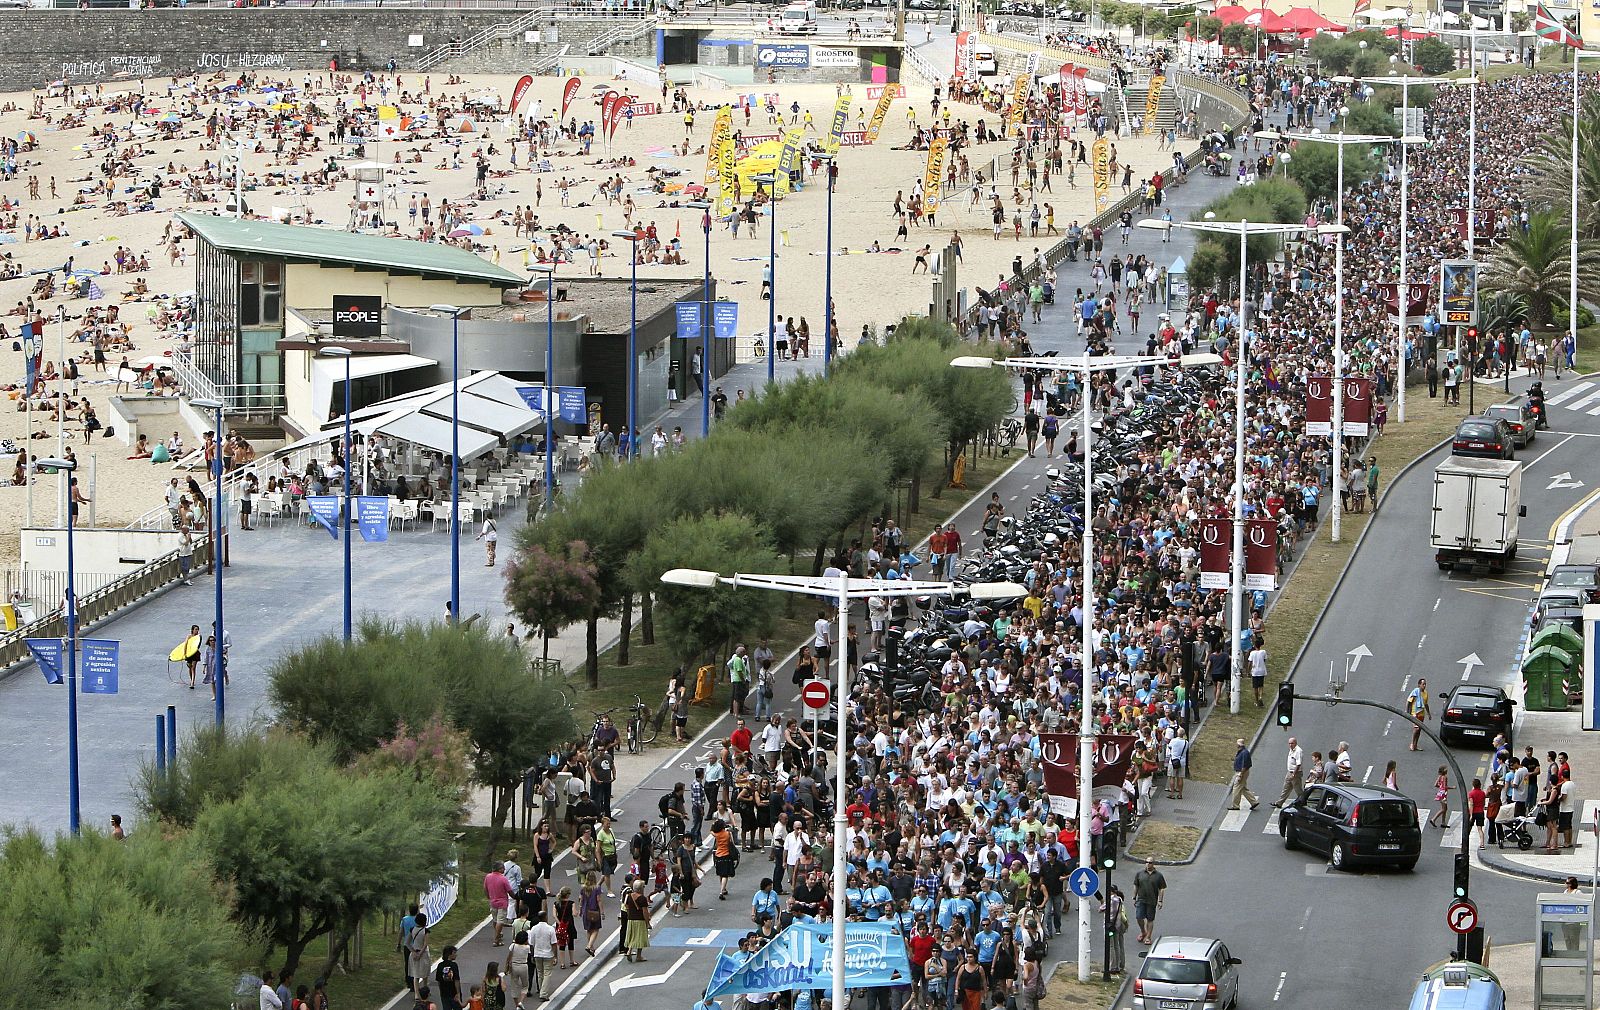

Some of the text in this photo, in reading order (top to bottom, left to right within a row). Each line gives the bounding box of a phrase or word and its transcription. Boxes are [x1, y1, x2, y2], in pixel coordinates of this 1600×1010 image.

[196, 52, 230, 68] JOSU
[874, 88, 896, 122] Schuss
[722, 149, 733, 193] Schuss
[927, 146, 944, 190] Schuss
[1096, 146, 1108, 190] Schuss
[336, 312, 378, 322] PEOPLE
